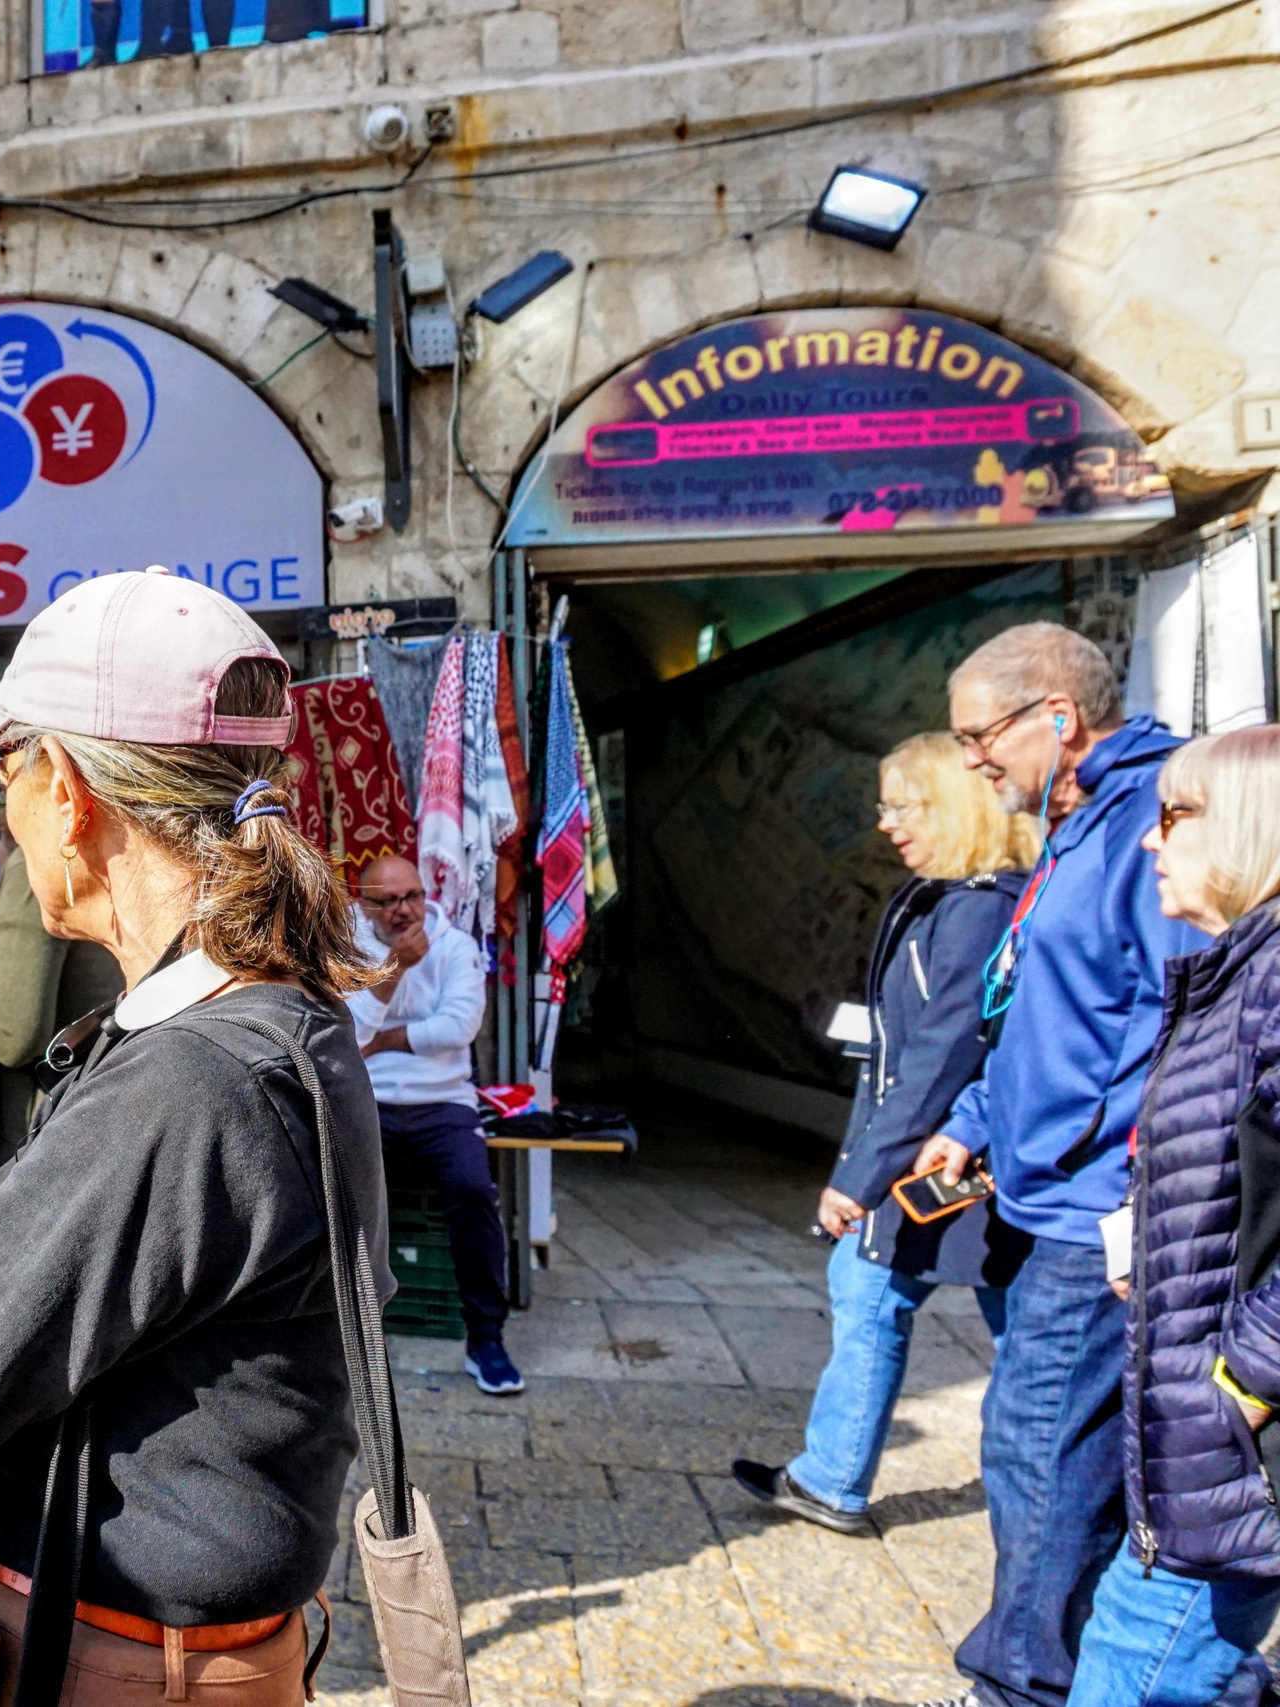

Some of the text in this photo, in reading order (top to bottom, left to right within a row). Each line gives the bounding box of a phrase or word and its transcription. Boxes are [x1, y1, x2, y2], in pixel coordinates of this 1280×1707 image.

[634, 325, 1026, 420] Information
[827, 386, 930, 410] Tours
[48, 556, 300, 604] CNGE
